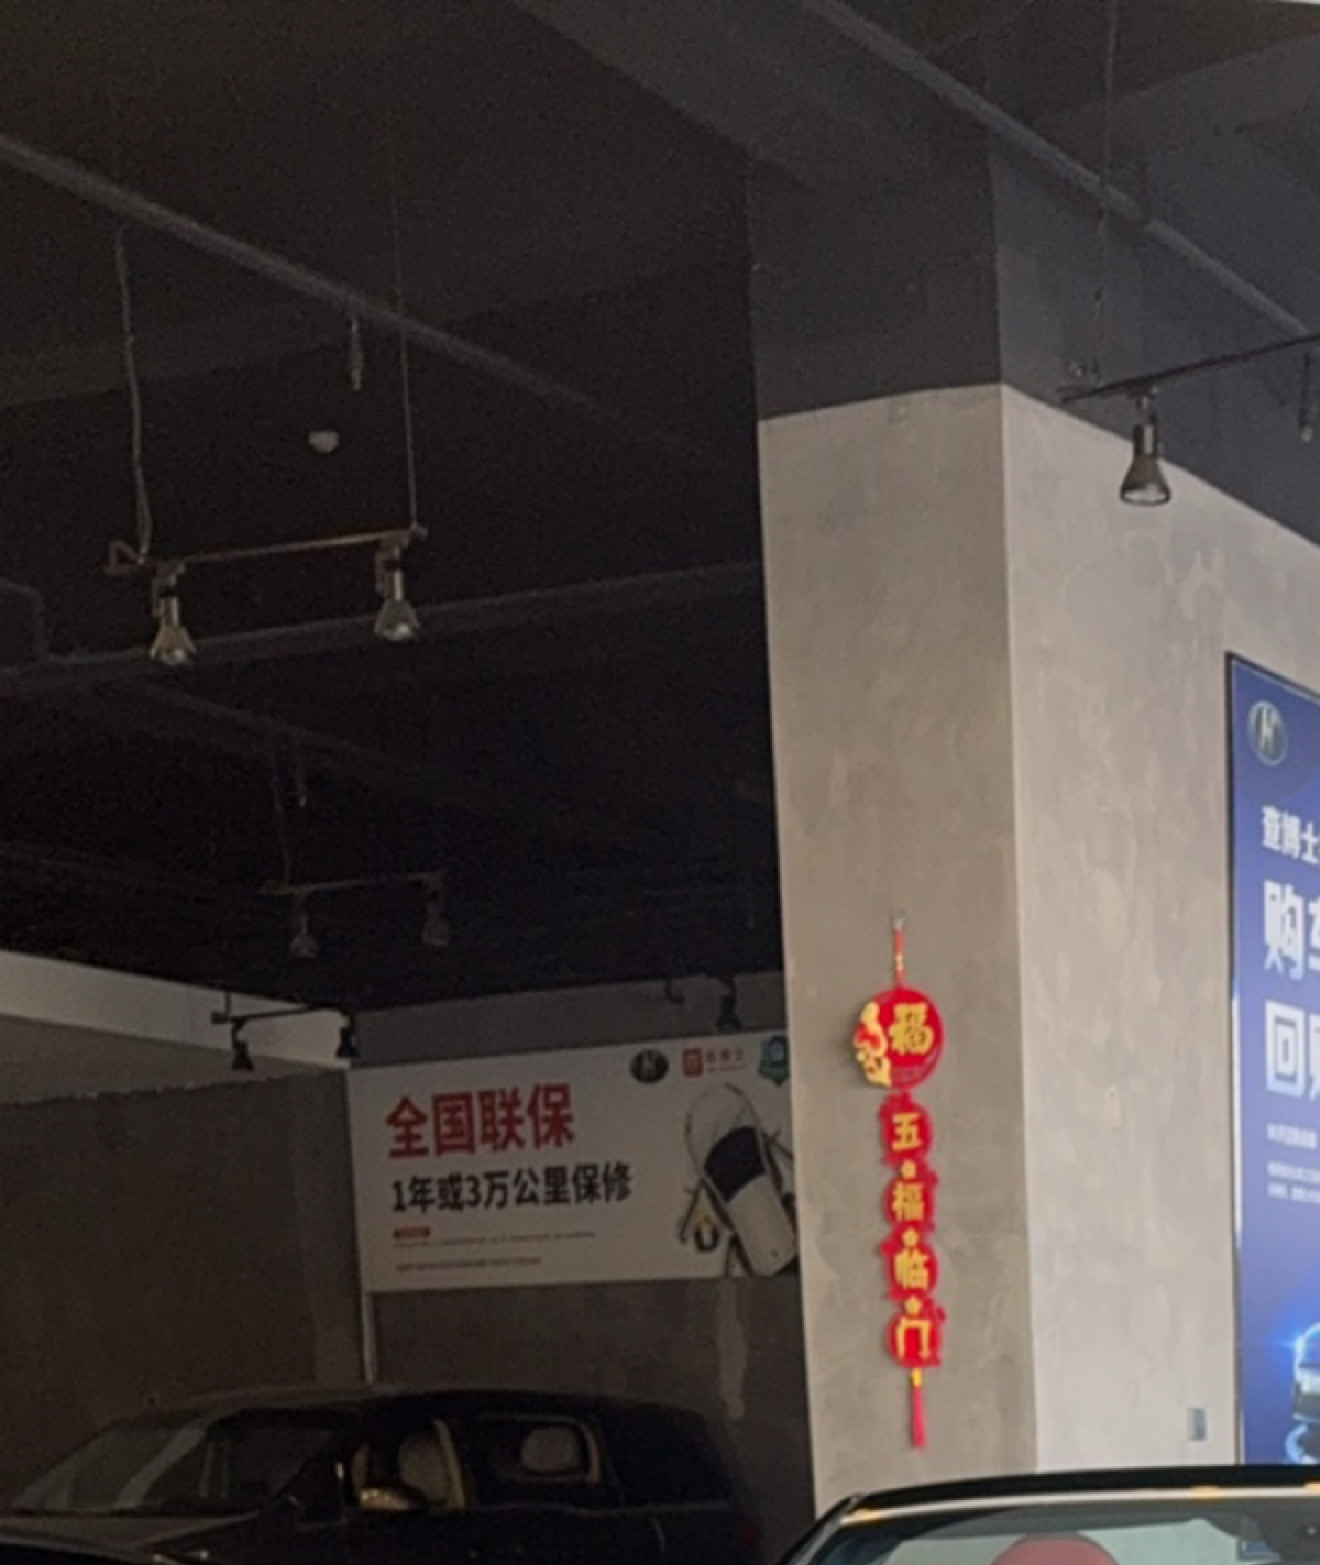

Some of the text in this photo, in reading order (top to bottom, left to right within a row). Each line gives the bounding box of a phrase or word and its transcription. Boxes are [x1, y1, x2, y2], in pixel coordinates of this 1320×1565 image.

[888, 1002, 935, 1056] 福
[386, 1082, 576, 1159] 全国联保
[392, 1161, 634, 1214] 1年或3万公里保修
[892, 1112, 932, 1361] 五福临门
